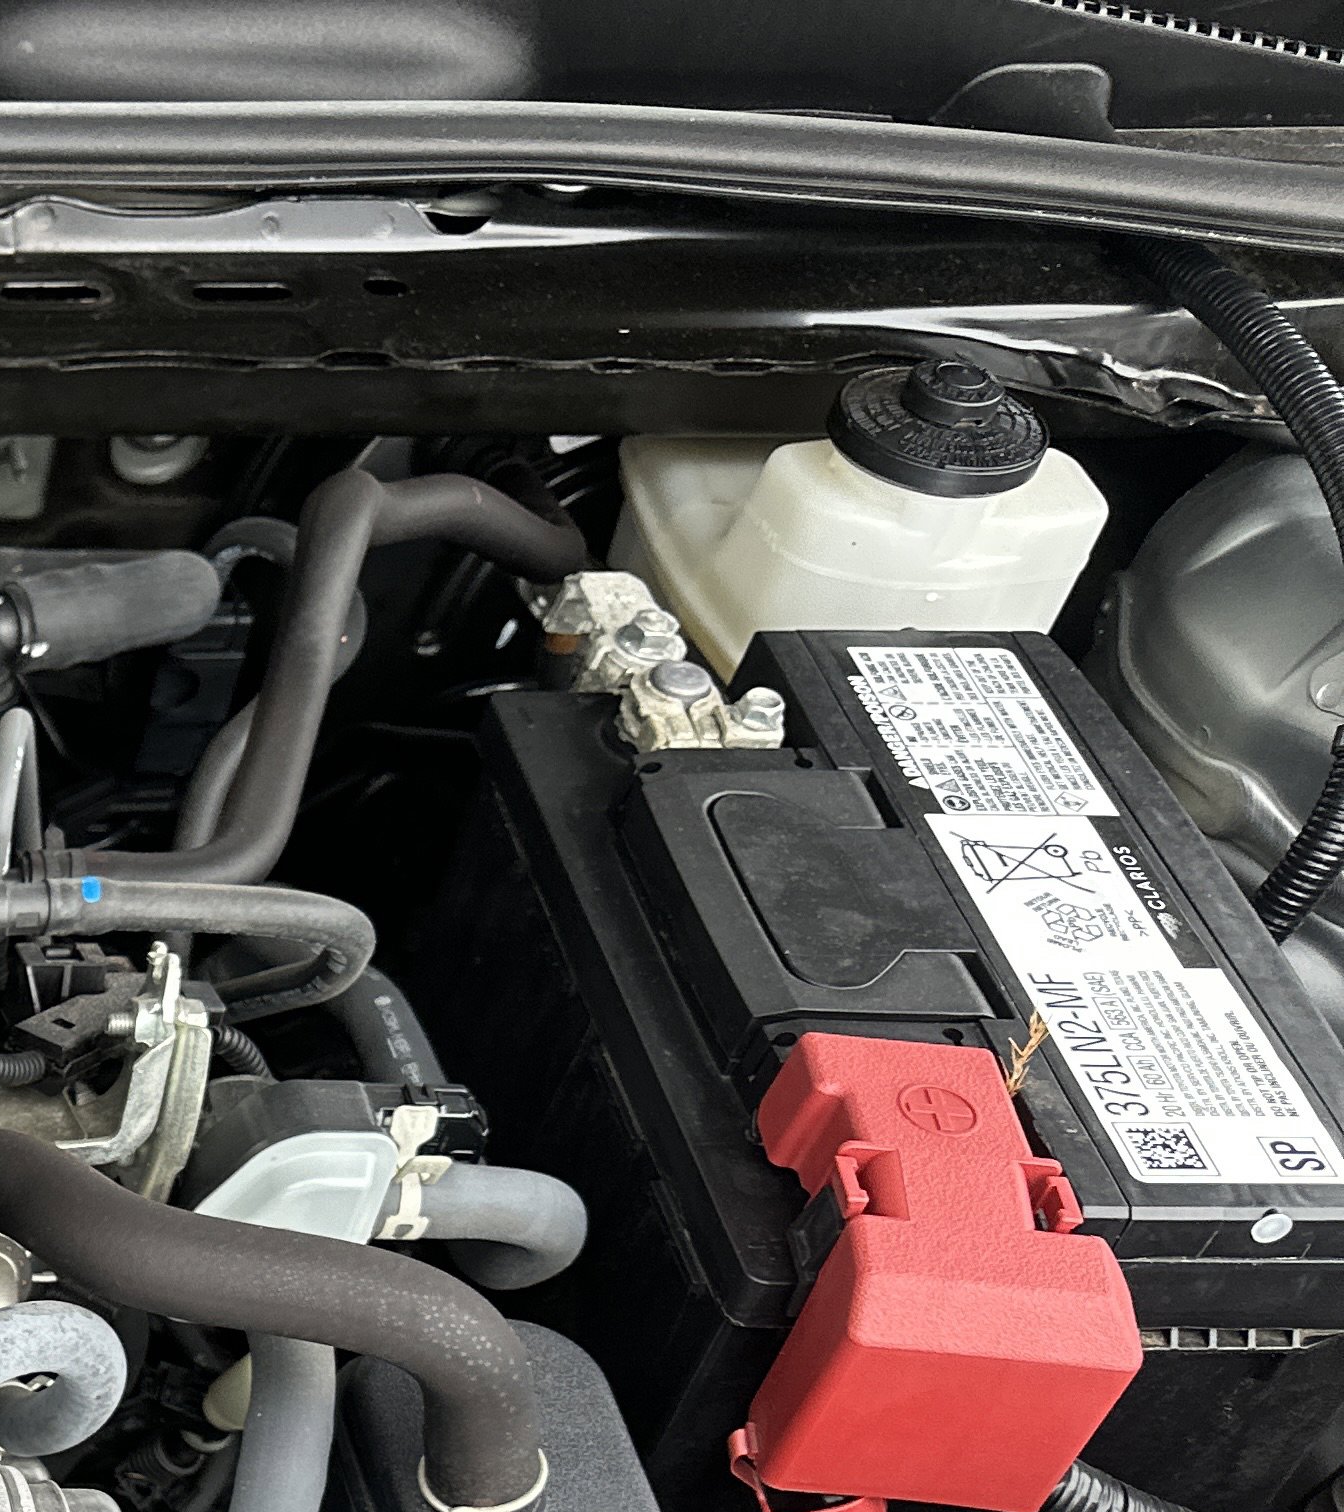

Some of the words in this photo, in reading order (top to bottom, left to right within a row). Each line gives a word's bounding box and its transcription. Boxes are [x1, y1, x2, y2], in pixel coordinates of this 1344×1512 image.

[1080, 850, 1112, 874] Pb
[1113, 846, 1166, 910] CLARIOS
[1083, 971, 1115, 996] (SAE)
[1099, 1000, 1119, 1008] A
[1104, 1009, 1131, 1026] 563
[1029, 974, 1148, 1116] 375LN2-MF
[1118, 1032, 1146, 1051] CCA
[1244, 1042, 1259, 1053] OU
[1136, 1059, 1156, 1072] Ah
[1242, 1062, 1259, 1074] OR
[1251, 1054, 1281, 1089] INCLINER
[1142, 1073, 1166, 1086] 60
[1250, 1074, 1265, 1087] TIP
[1155, 1091, 1177, 1103] Hr
[1258, 1088, 1277, 1104] NOT
[1274, 1090, 1292, 1106] PAS
[1161, 1105, 1187, 1118] 20
[1270, 1105, 1286, 1117] DO
[1284, 1107, 1300, 1118] NE
[1270, 1140, 1325, 1171] SP
